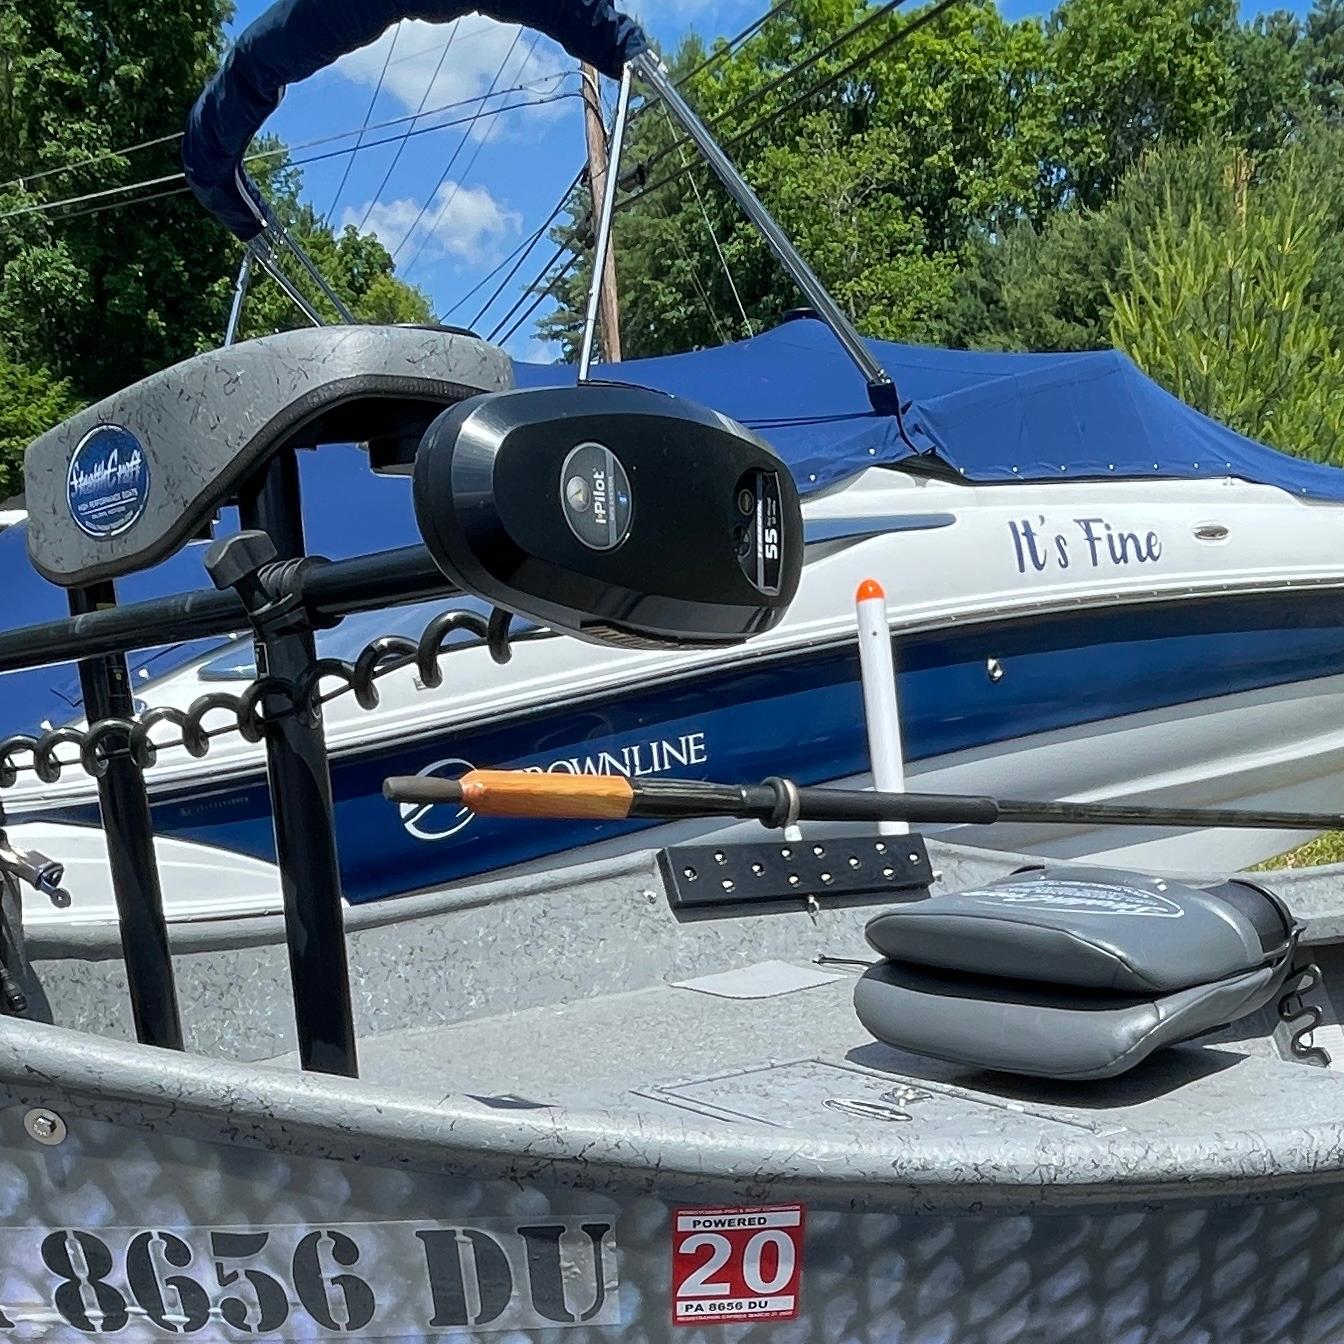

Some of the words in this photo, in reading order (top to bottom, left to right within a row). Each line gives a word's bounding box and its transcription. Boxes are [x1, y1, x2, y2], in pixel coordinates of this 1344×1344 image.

[764, 528, 778, 560] 55
[1008, 514, 1069, 573] It's
[1073, 518, 1162, 567] Fine
[692, 1217, 768, 1228] POWERED
[41, 1227, 375, 1333] 8656
[416, 1222, 614, 1328] DU
[676, 1229, 796, 1297] 20
[684, 1304, 704, 1312] PA
[709, 1302, 743, 1311] 8656
[748, 1301, 768, 1309] DU
